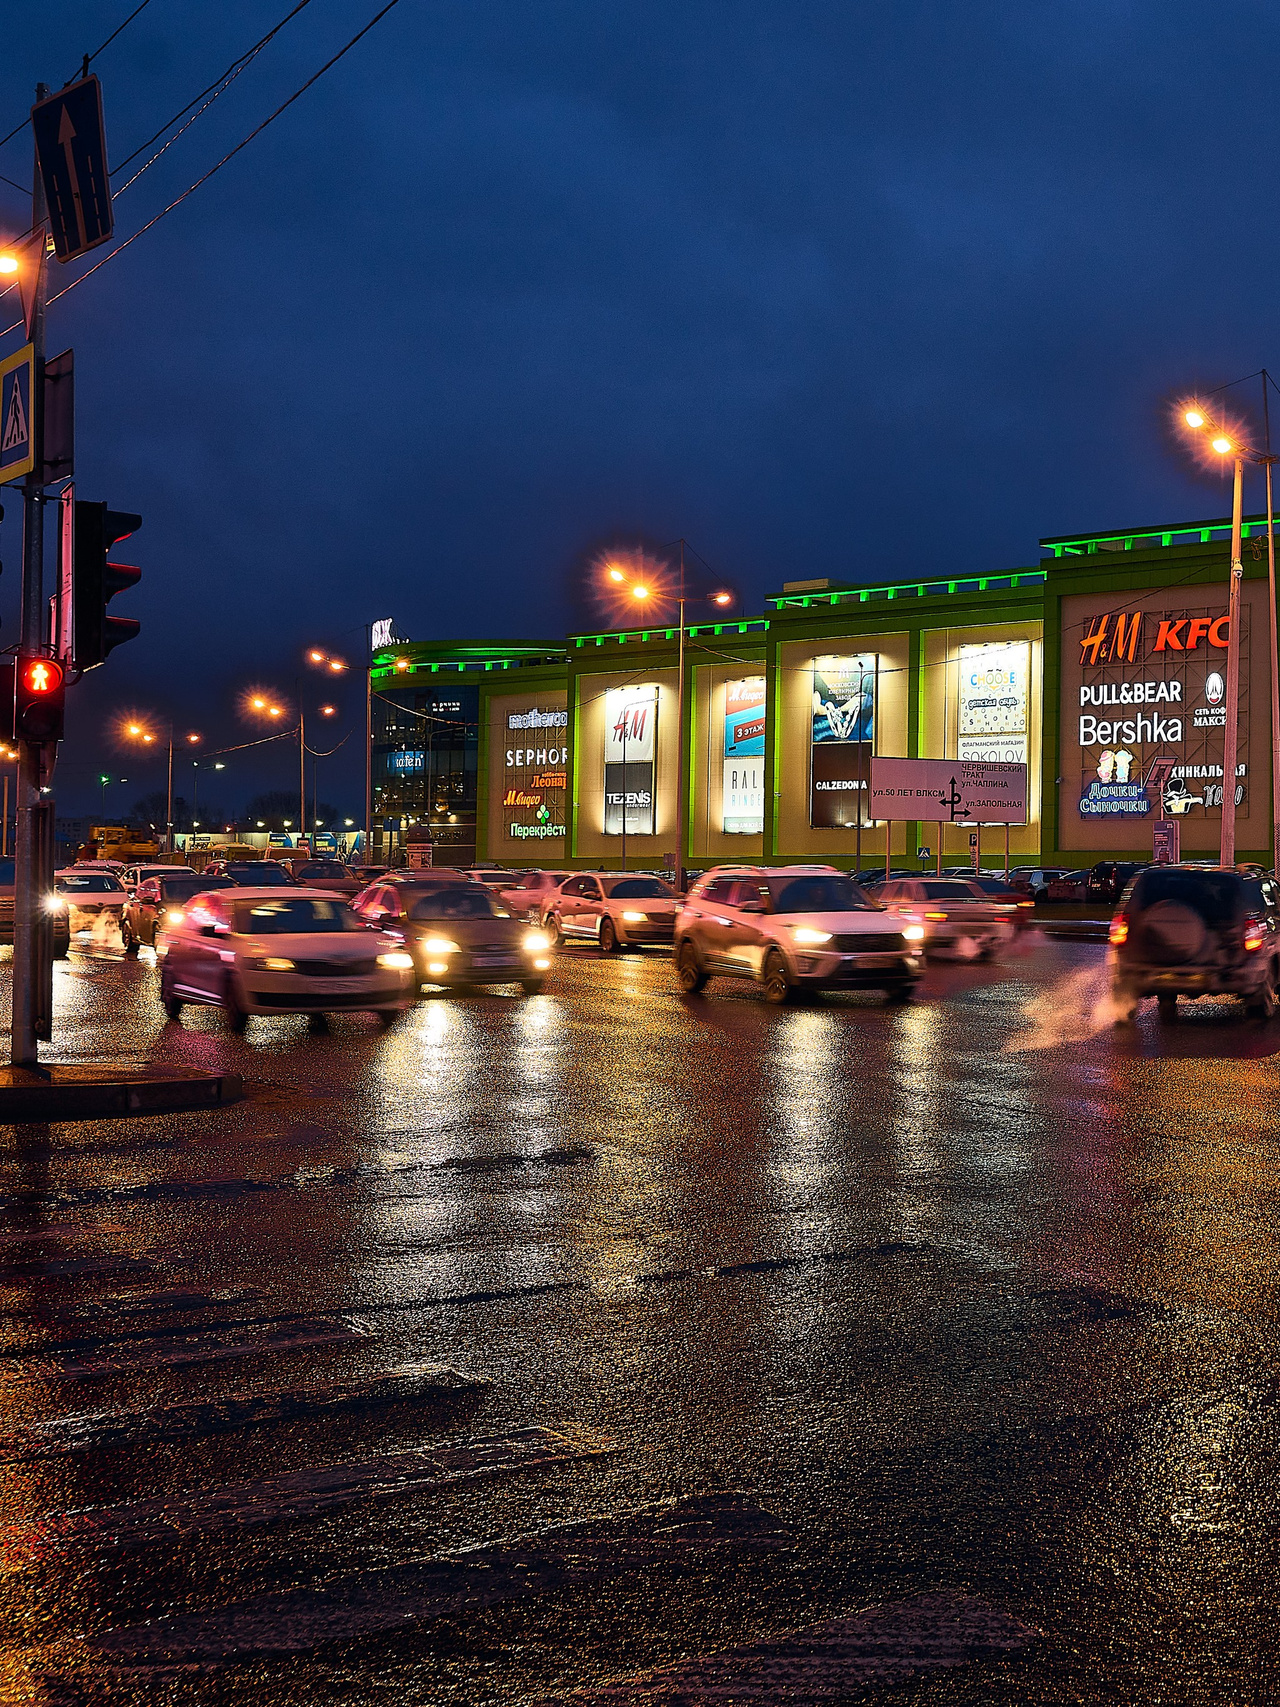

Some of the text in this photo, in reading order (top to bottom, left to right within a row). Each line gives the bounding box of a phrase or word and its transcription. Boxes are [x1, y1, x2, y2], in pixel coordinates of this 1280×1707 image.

[1079, 611, 1231, 665] H&M KFC
[970, 671, 1015, 686] CHOOSE
[1079, 681, 1182, 707] PULL&BEAR
[1194, 708, 1210, 716] СЕТЬ
[737, 723, 764, 738] 3 ЭТАЖ
[1079, 712, 1182, 745] Bershka
[961, 764, 1022, 773] ЧЕРВИШЕВСКИЙ
[732, 770, 764, 789] RAL
[815, 780, 867, 790] CALZEDONA
[961, 780, 1008, 788] ул.ЧАПЛИНА
[503, 790, 541, 808] М.видео
[872, 789, 895, 797] ул.50
[916, 789, 945, 797] ВЛКСМ
[965, 800, 1022, 808] ул.ЗАПОЛЬНАЯ
[1079, 798, 1148, 813] Сыночки
